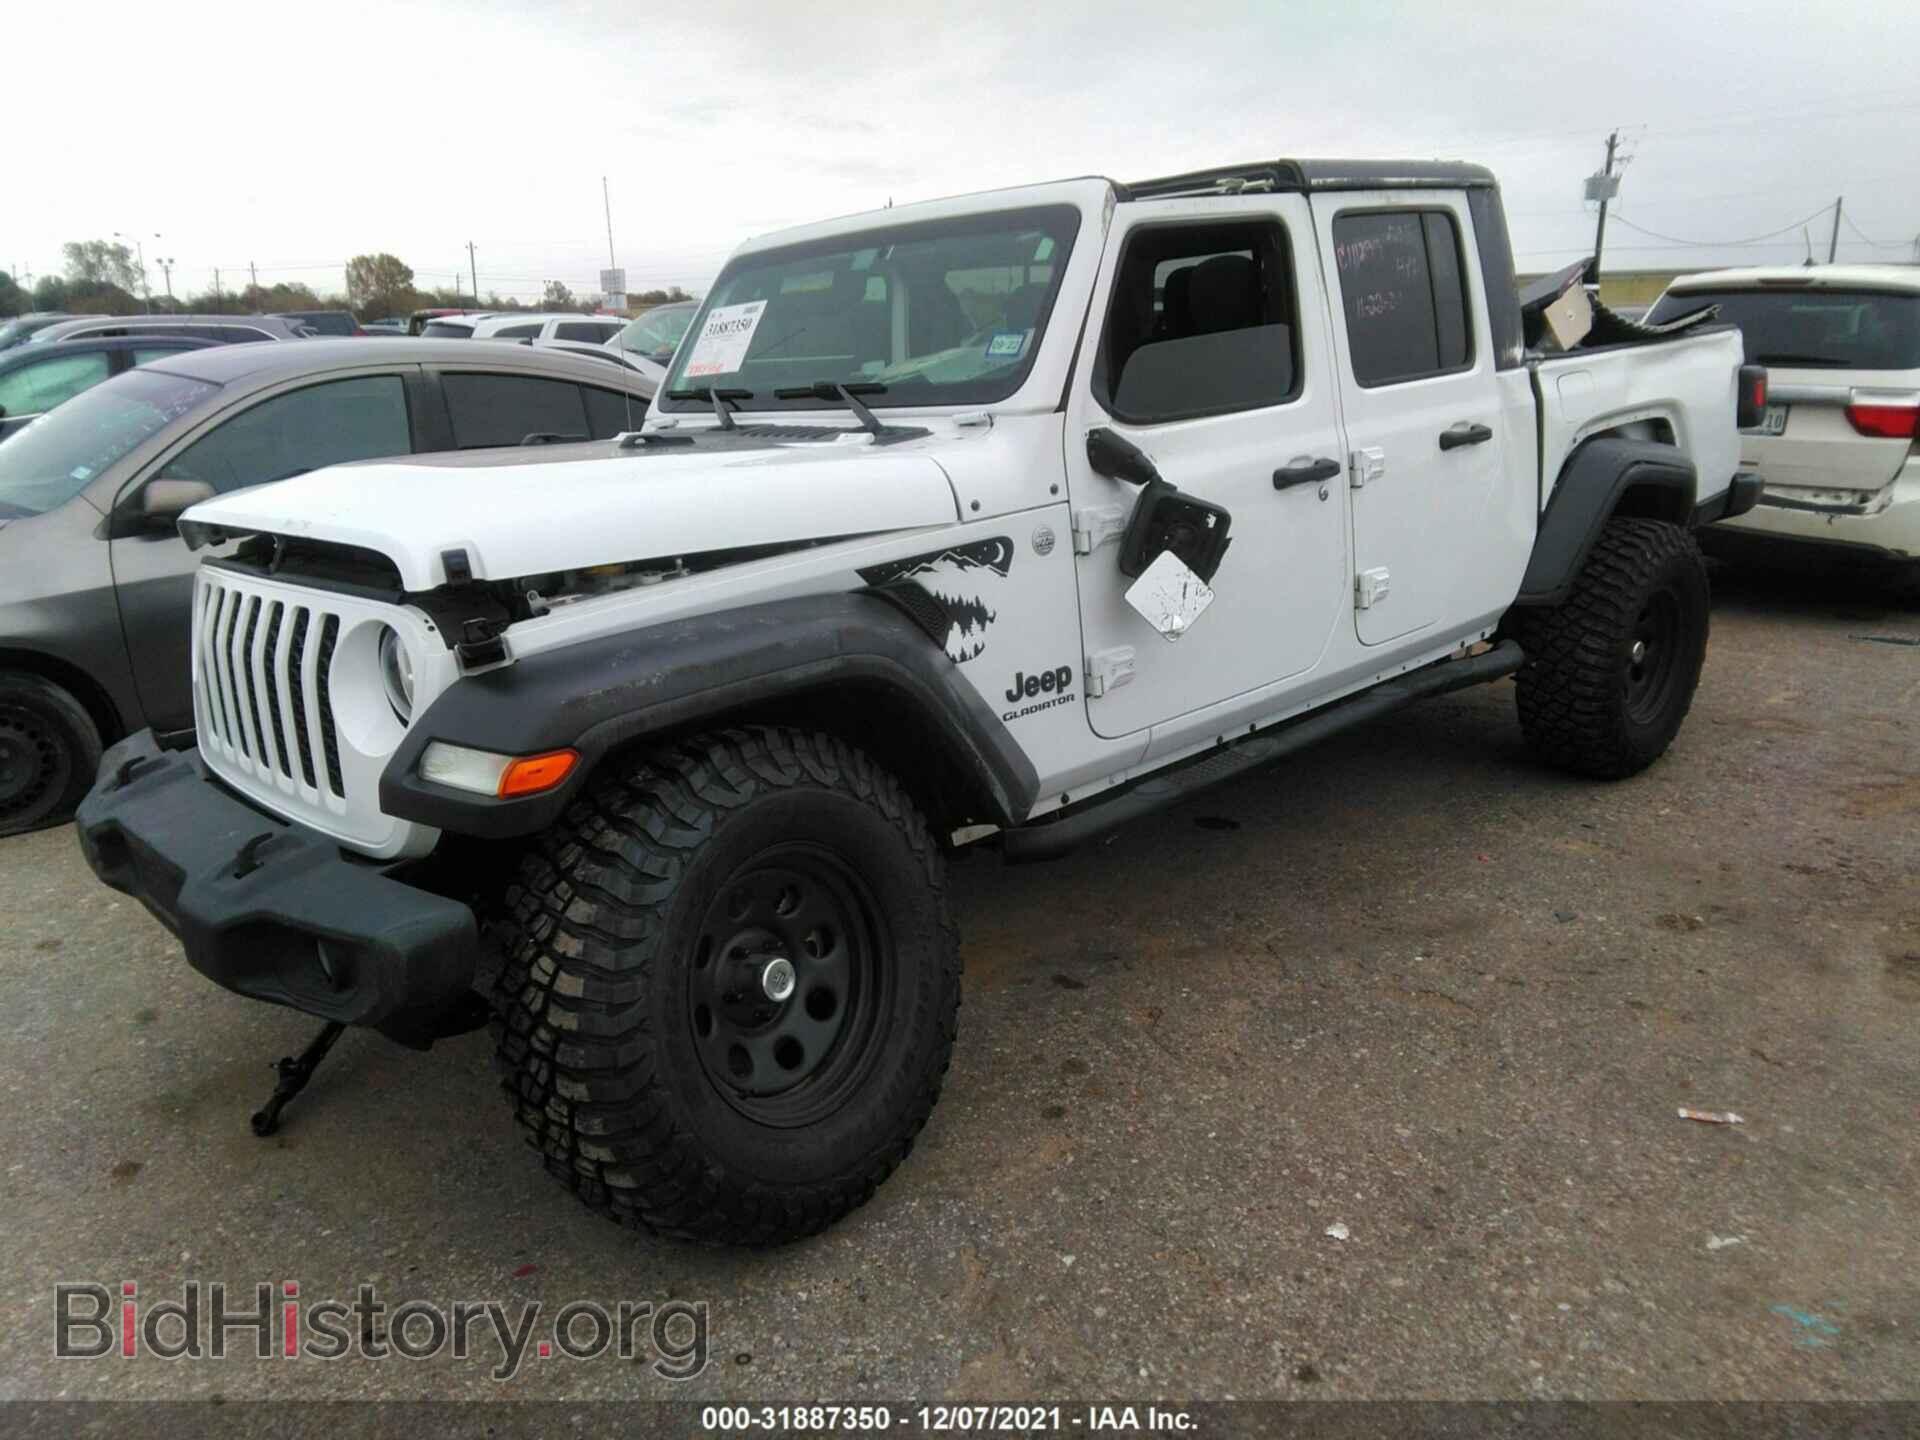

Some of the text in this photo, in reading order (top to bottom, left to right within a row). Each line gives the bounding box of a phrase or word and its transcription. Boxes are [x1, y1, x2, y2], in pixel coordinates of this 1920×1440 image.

[705, 318, 754, 337] 31887350
[1006, 665, 1072, 703] Jeep
[1002, 693, 1076, 722] GLADIATOR
